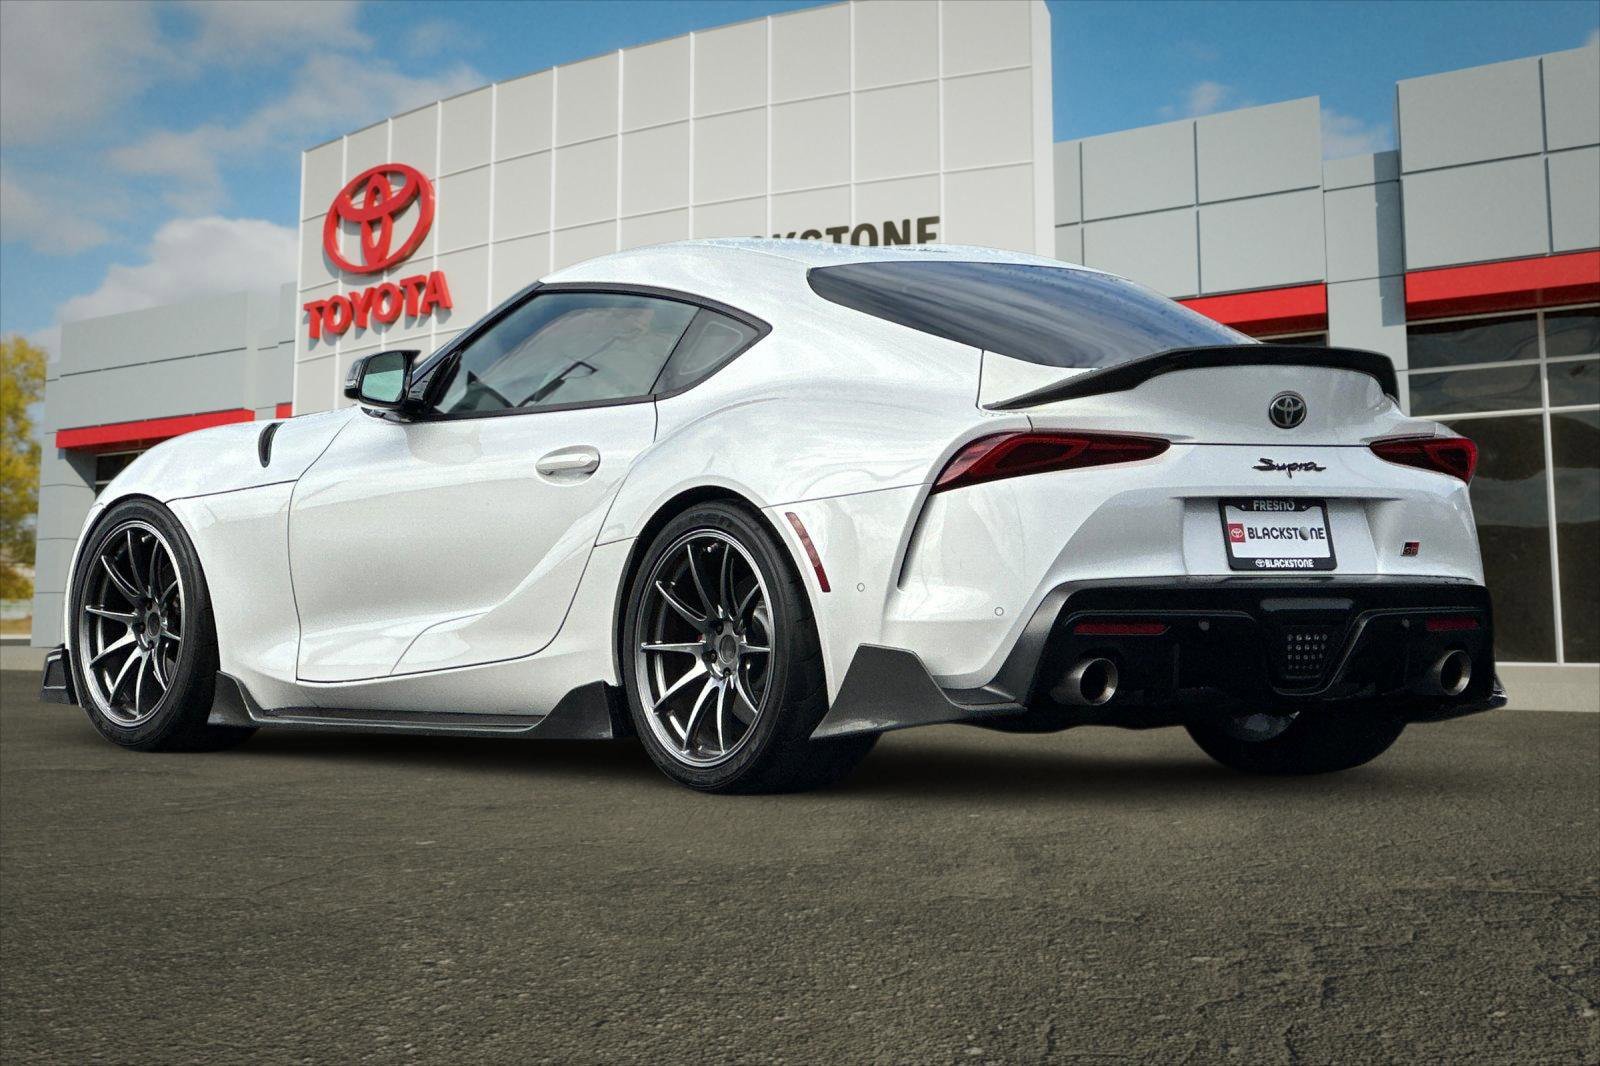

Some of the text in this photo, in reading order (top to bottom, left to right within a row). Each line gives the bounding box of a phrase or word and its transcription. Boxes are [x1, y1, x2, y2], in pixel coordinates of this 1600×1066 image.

[303, 271, 452, 339] TOYOTA
[1252, 458, 1326, 478] Supra
[1253, 500, 1295, 511] FRESNO
[1266, 559, 1314, 568] BLACKSTONE
